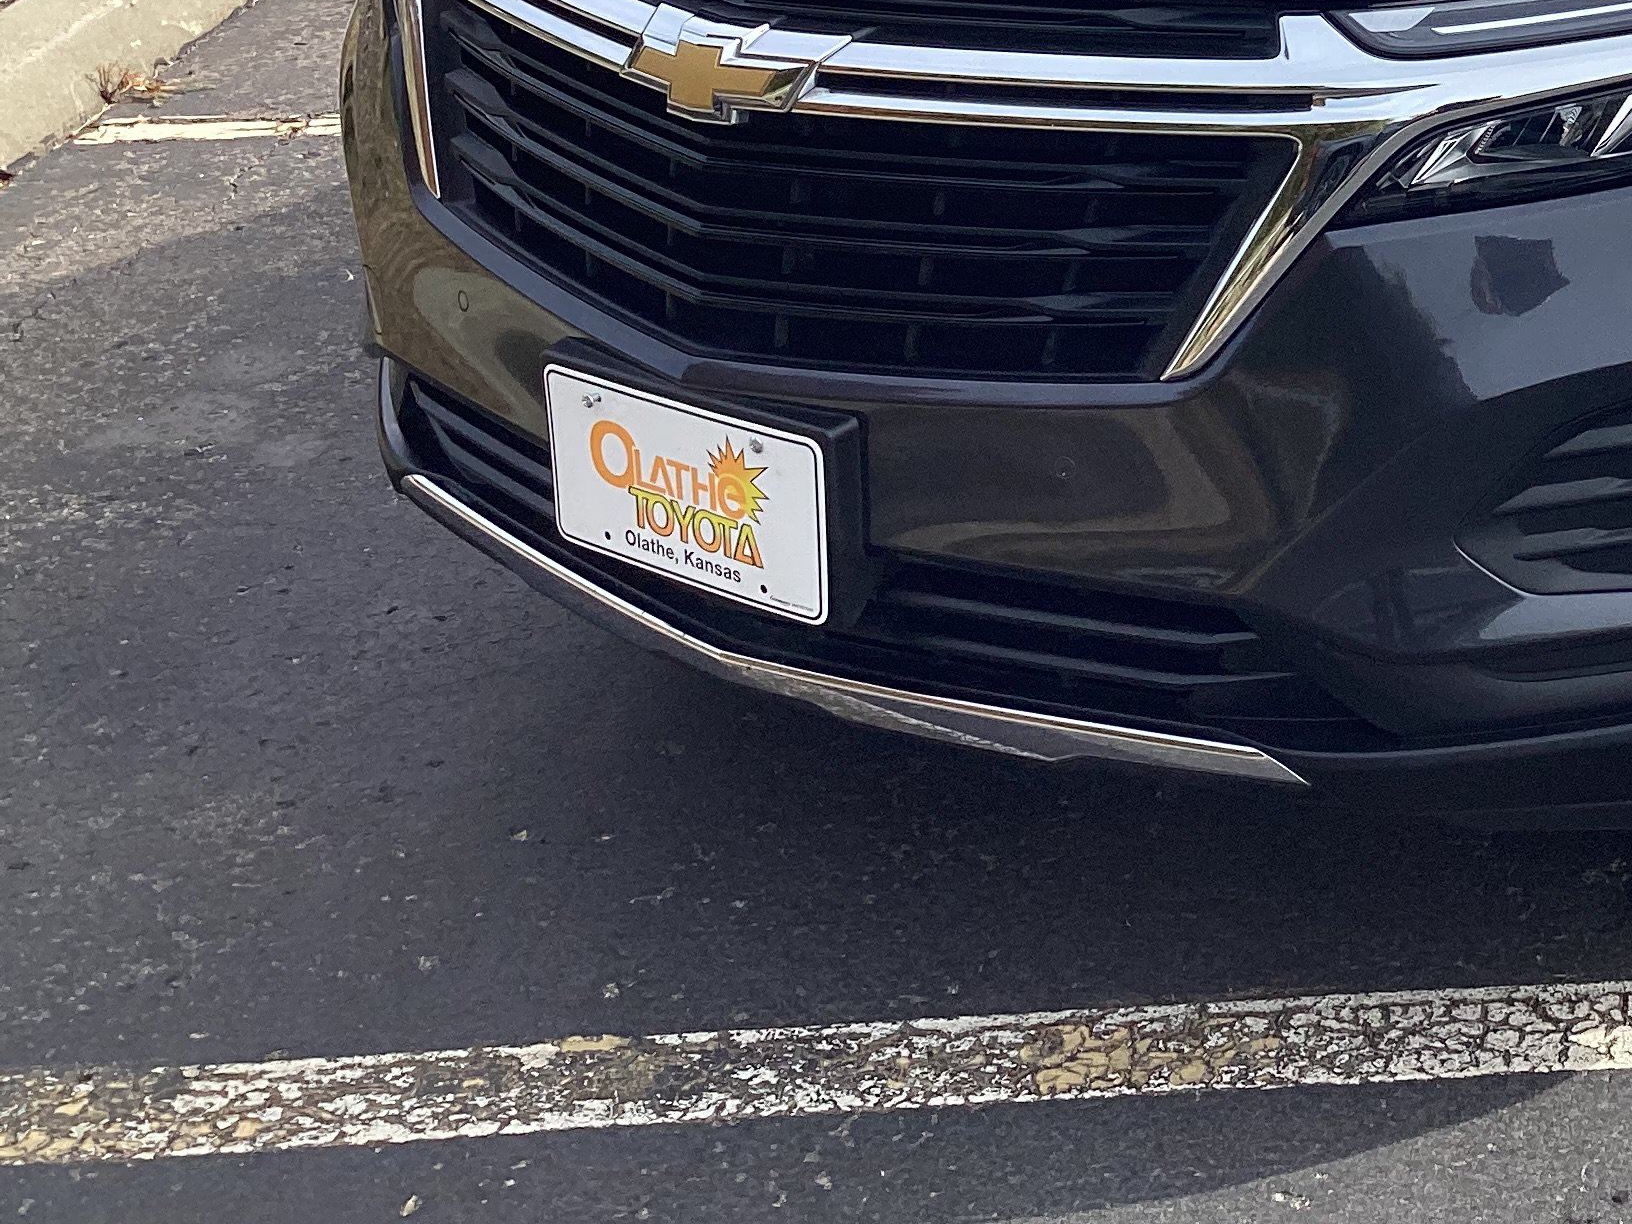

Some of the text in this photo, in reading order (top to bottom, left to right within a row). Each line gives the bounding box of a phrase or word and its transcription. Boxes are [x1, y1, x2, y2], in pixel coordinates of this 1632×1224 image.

[625, 529, 742, 583] Olathe, Kansas
[628, 485, 764, 569] TOYOTA
